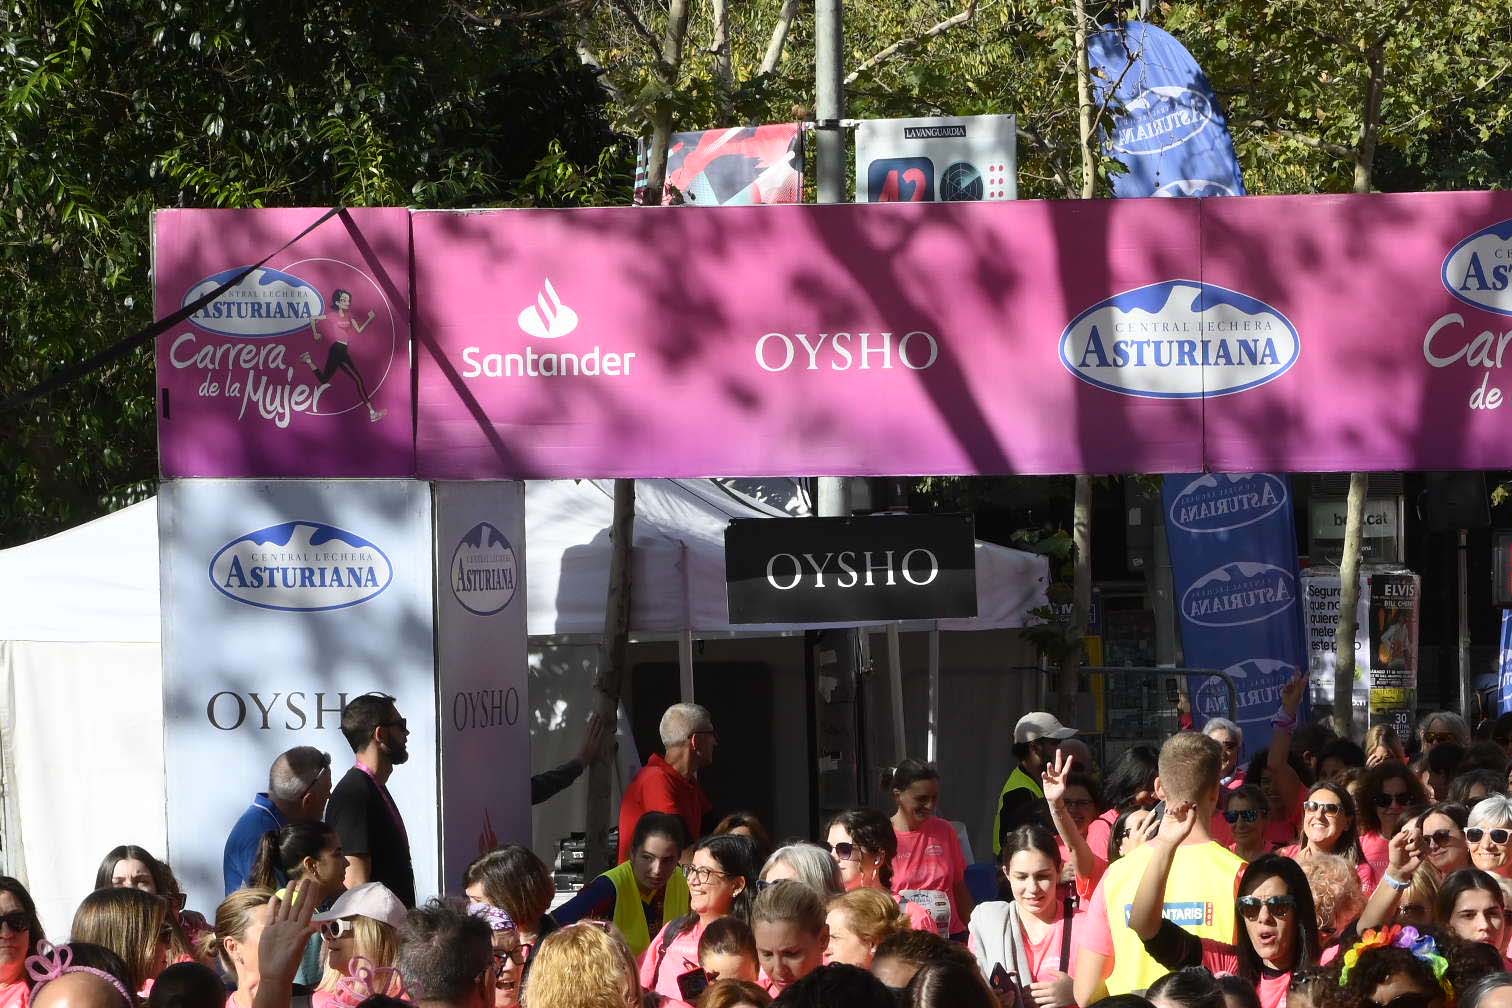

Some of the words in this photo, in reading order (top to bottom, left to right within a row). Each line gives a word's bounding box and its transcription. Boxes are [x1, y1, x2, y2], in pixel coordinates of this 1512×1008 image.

[191, 292, 312, 321] ASTURIANA
[1114, 321, 1192, 333] CENTRAL
[169, 332, 288, 370] Carrera
[462, 346, 637, 378] Santander
[754, 331, 939, 374] OYSHO
[1077, 324, 1281, 369] ASTURIANA
[198, 370, 220, 398] de
[225, 371, 241, 398] la
[237, 366, 332, 429] Mujer
[1468, 371, 1504, 411] de
[223, 553, 381, 590] ASTURIANA
[250, 551, 307, 563] CENTRAL
[312, 551, 374, 563] LECHERA
[455, 557, 515, 592] ASTURIANA
[766, 547, 939, 591] OYSHO
[1384, 584, 1415, 596] ELVIS
[206, 691, 396, 732] OYSH
[453, 687, 520, 732] OYSHO
[1125, 901, 1204, 928] VNTARIS
